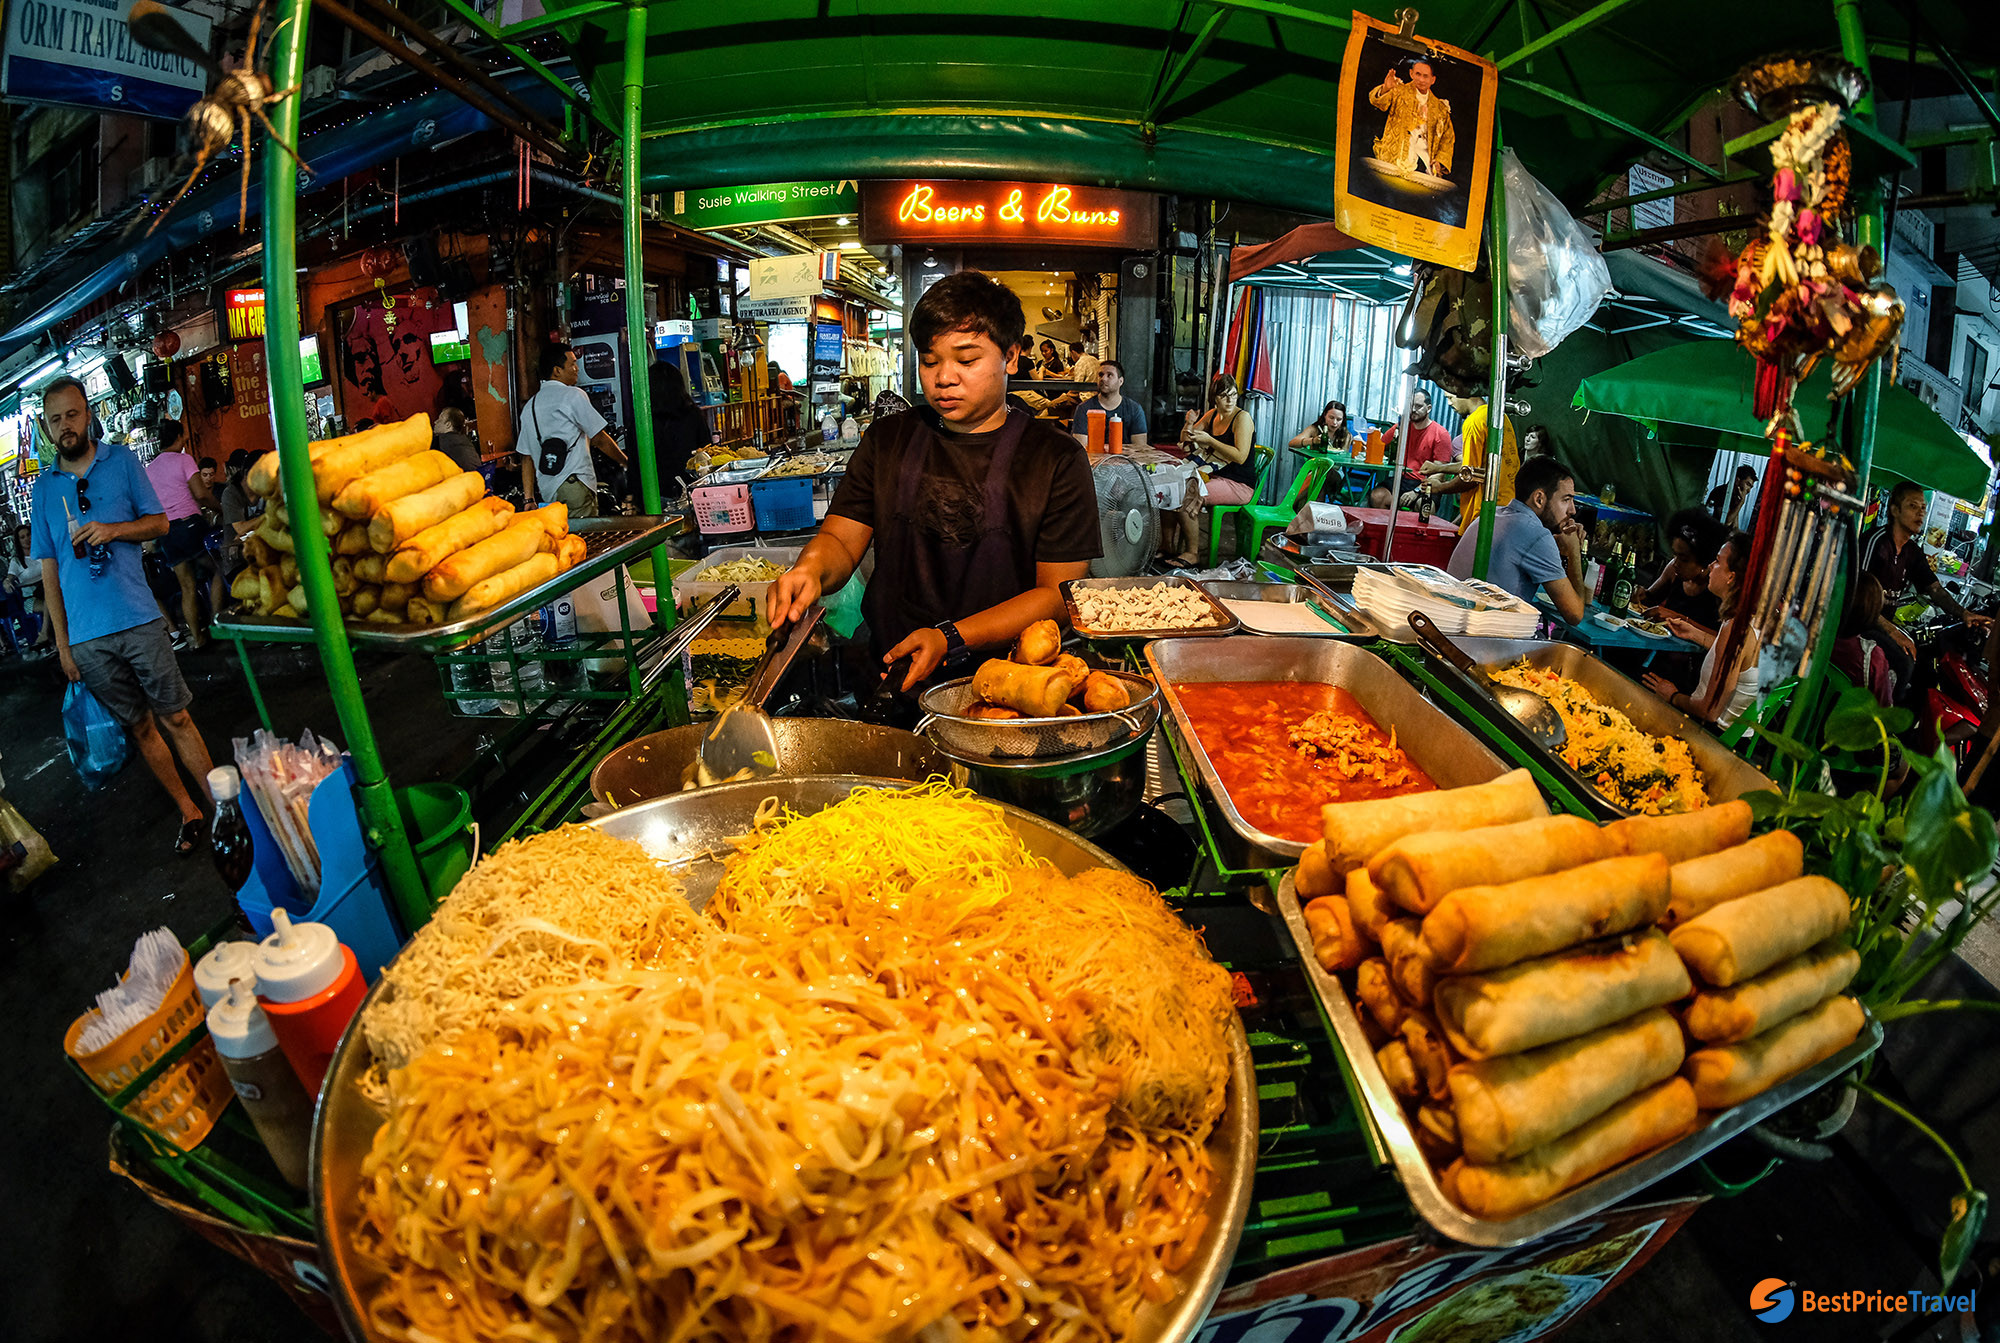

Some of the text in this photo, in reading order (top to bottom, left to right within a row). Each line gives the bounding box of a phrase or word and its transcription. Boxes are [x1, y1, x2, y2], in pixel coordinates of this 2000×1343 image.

[20, 0, 67, 51] ORM
[70, 10, 136, 65] TRAVEL
[698, 183, 835, 210] Susie Walking Street
[899, 183, 1121, 226] Beers & Buns
[228, 307, 247, 339] NAT
[248, 305, 266, 337] GUE
[781, 306, 808, 316] AGENCY
[235, 375, 260, 393] the
[255, 389, 267, 401] Ev
